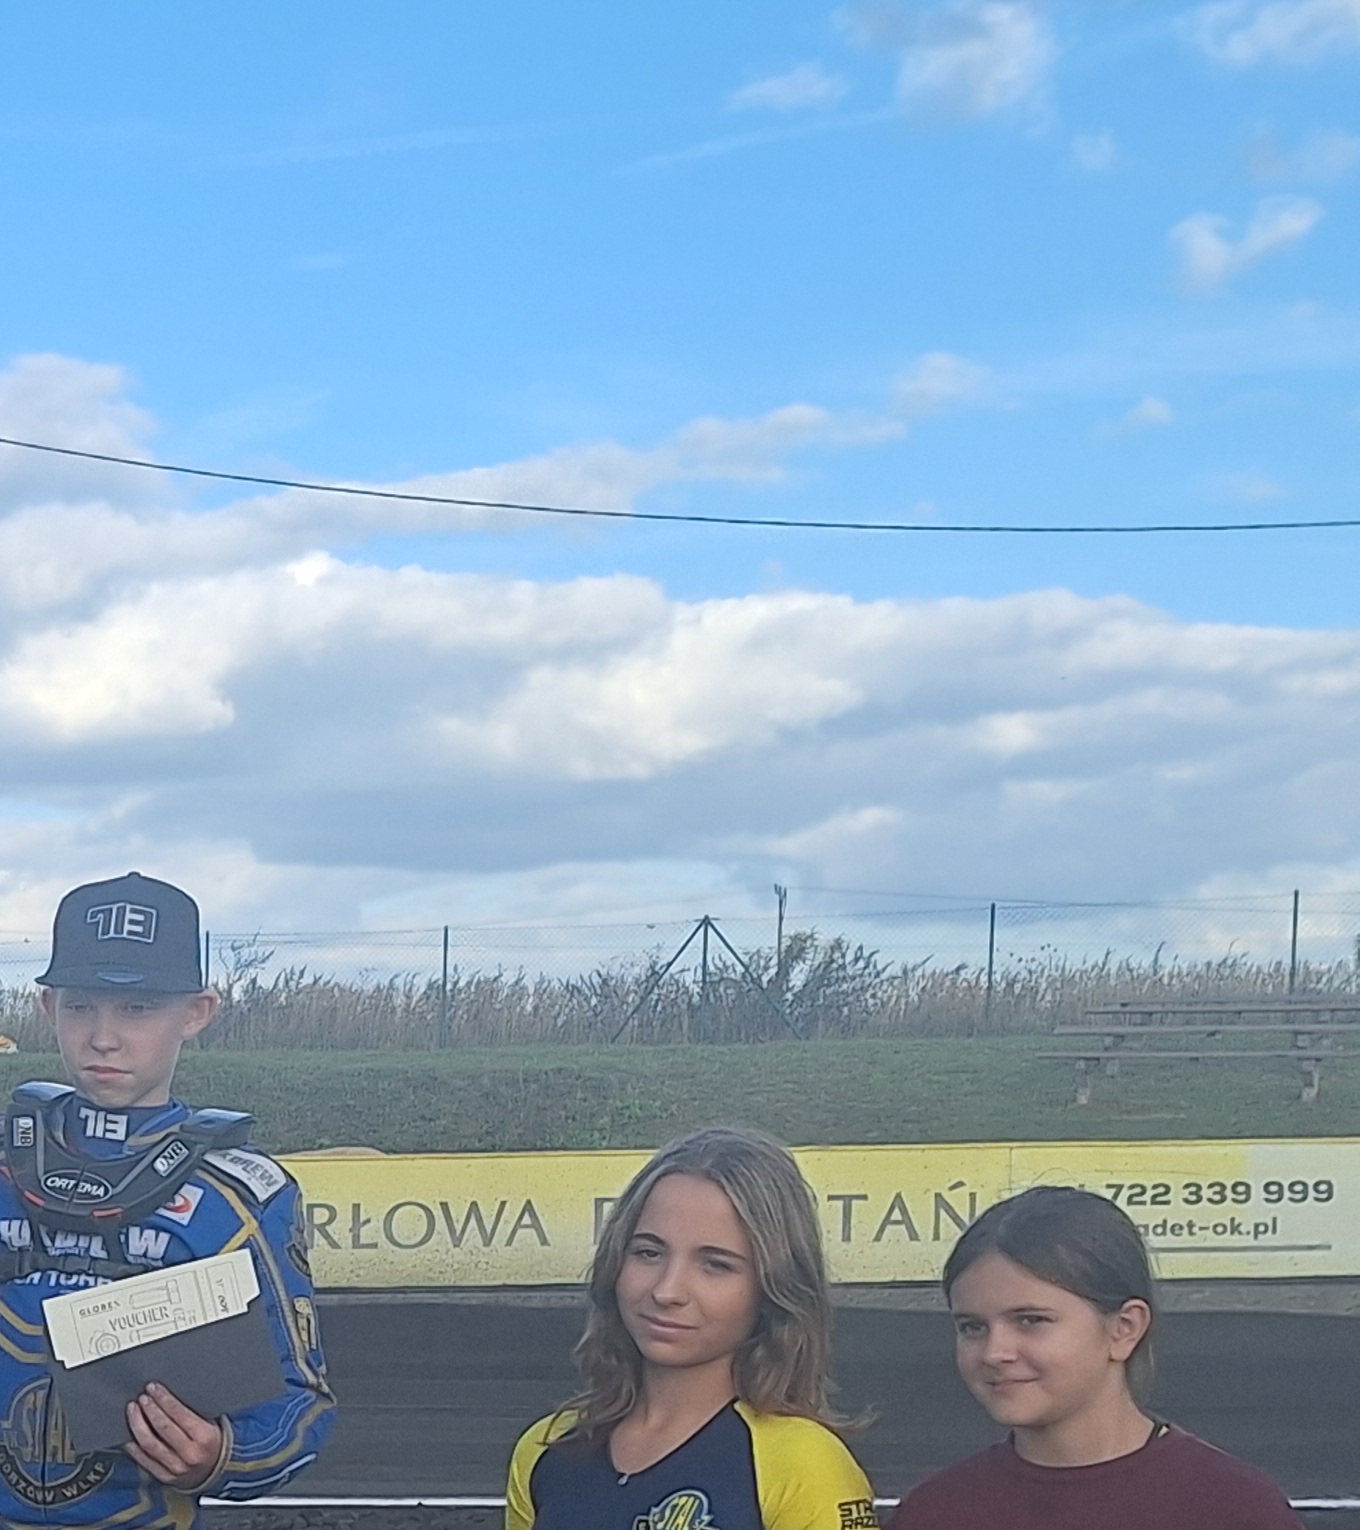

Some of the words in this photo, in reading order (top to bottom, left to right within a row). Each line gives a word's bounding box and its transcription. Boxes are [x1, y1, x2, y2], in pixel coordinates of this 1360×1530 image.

[1105, 1182, 1172, 1206] 722
[1182, 1181, 1252, 1206] 339
[1262, 1179, 1334, 1204] 999
[304, 1198, 552, 1250] RŁOWA
[1137, 1217, 1278, 1241] adet-ok.pl
[108, 1305, 170, 1332] VOUCHER
